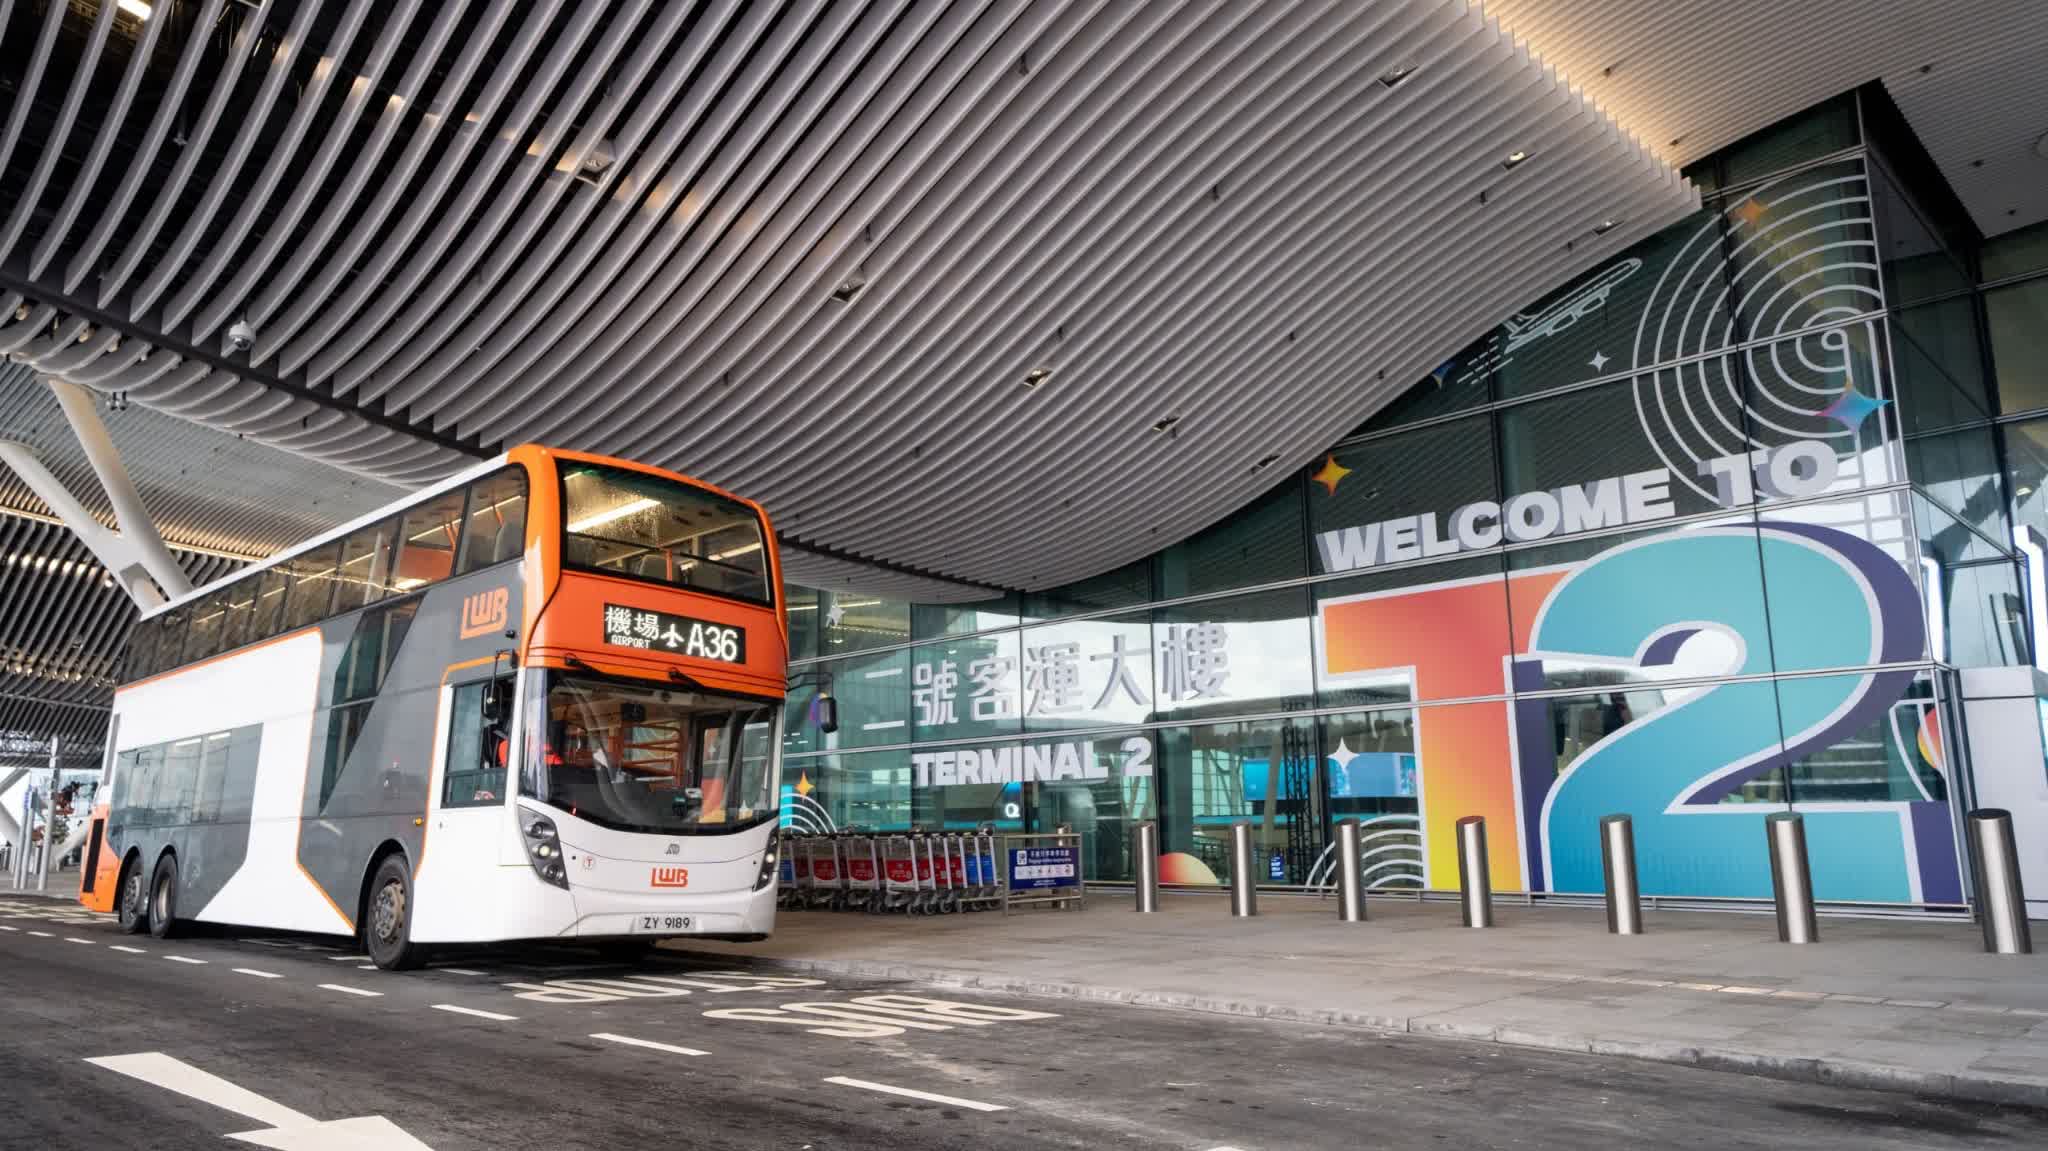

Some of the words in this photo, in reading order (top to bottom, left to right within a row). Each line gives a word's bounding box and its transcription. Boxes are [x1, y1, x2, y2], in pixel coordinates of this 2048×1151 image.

[1316, 468, 1675, 573] WELCOME
[1700, 439, 1838, 508] TO
[460, 586, 508, 640] LWB
[605, 606, 660, 640] 機場
[611, 634, 651, 649] AIRPORT
[686, 623, 738, 661] A36
[863, 621, 1231, 730] 二號客運大樓
[1317, 521, 1962, 910] T2
[912, 741, 1109, 787] TERMINAL
[1120, 737, 1153, 777] 2
[651, 867, 688, 888] LWB
[643, 917, 660, 929] ZY
[664, 917, 690, 929] 9189
[501, 971, 827, 1003] STOP
[702, 995, 1062, 1038] BUS
